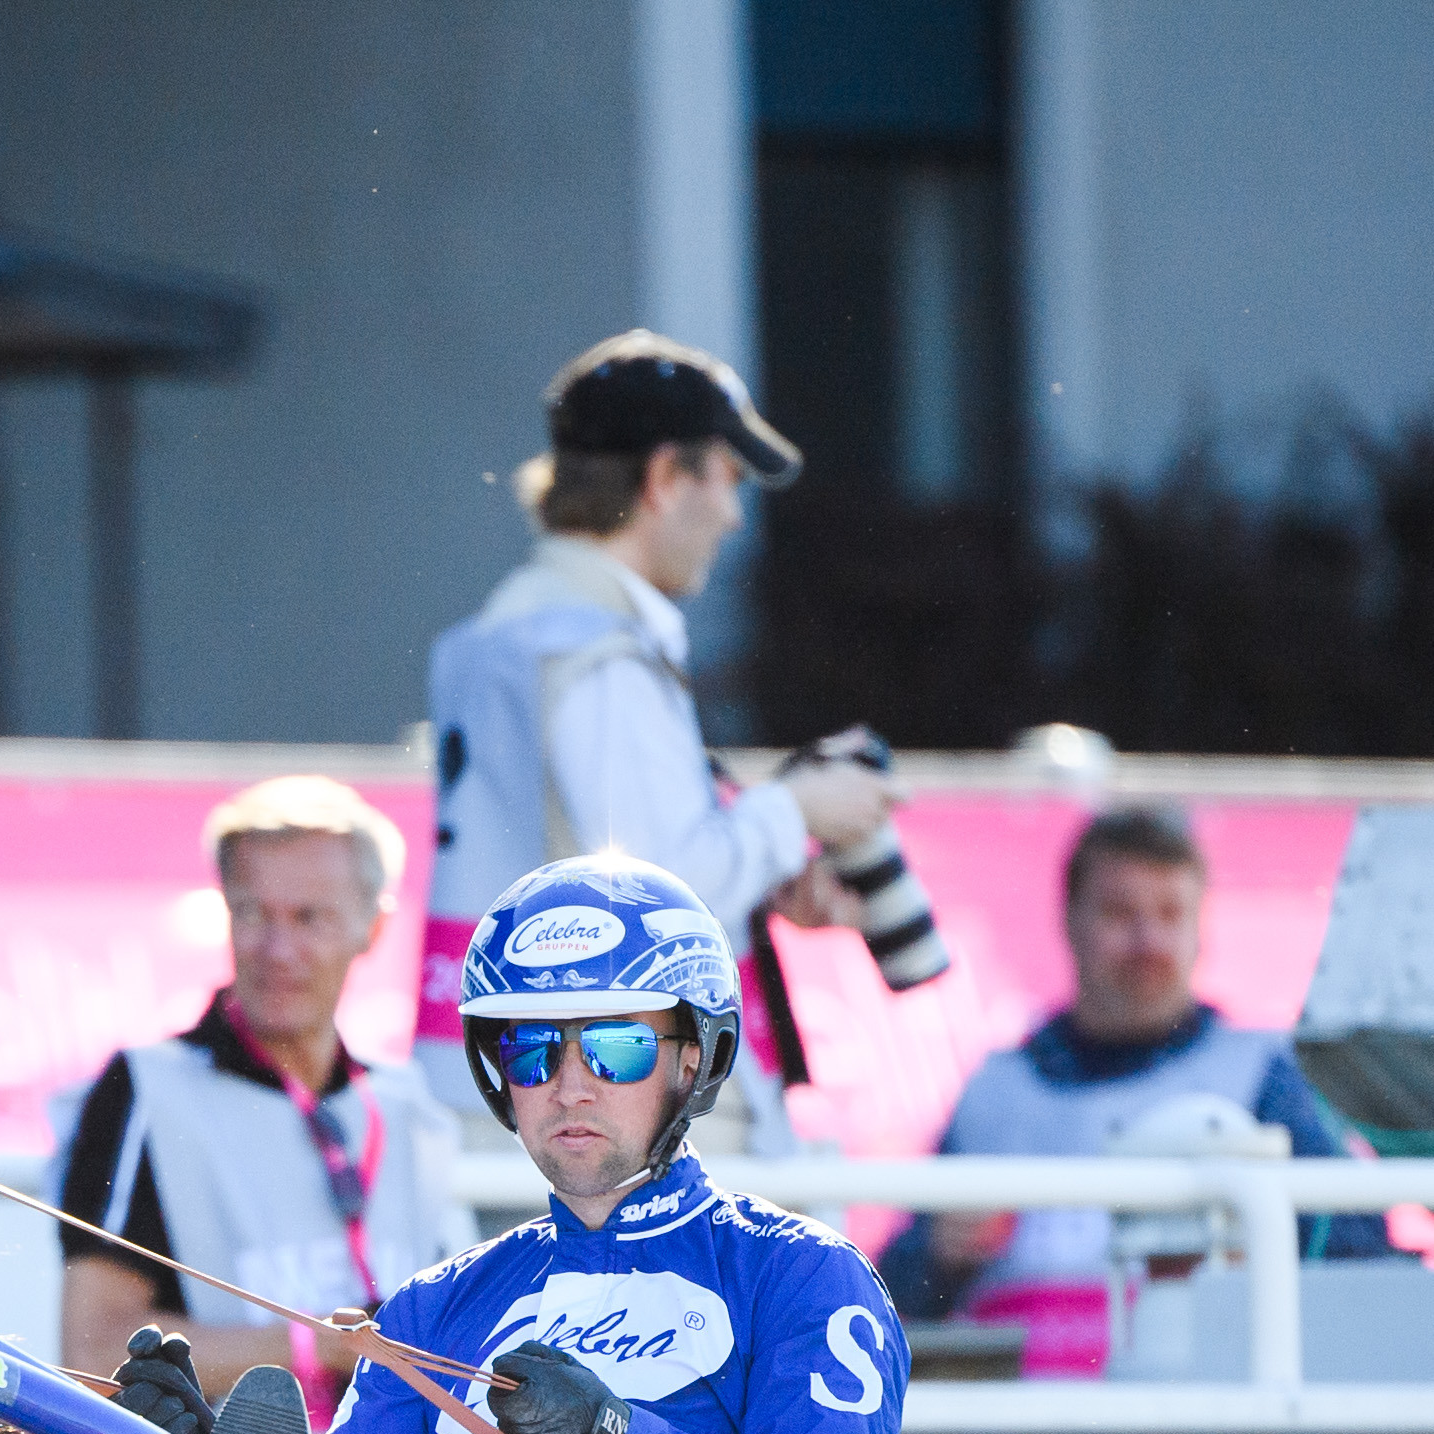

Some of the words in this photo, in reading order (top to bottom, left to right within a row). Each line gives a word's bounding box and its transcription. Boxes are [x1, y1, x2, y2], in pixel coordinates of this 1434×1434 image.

[512, 917, 602, 954] Celebra
[537, 943, 589, 951] GRUPPEN
[453, 1308, 678, 1408] Clebra
[810, 1305, 885, 1415] S
